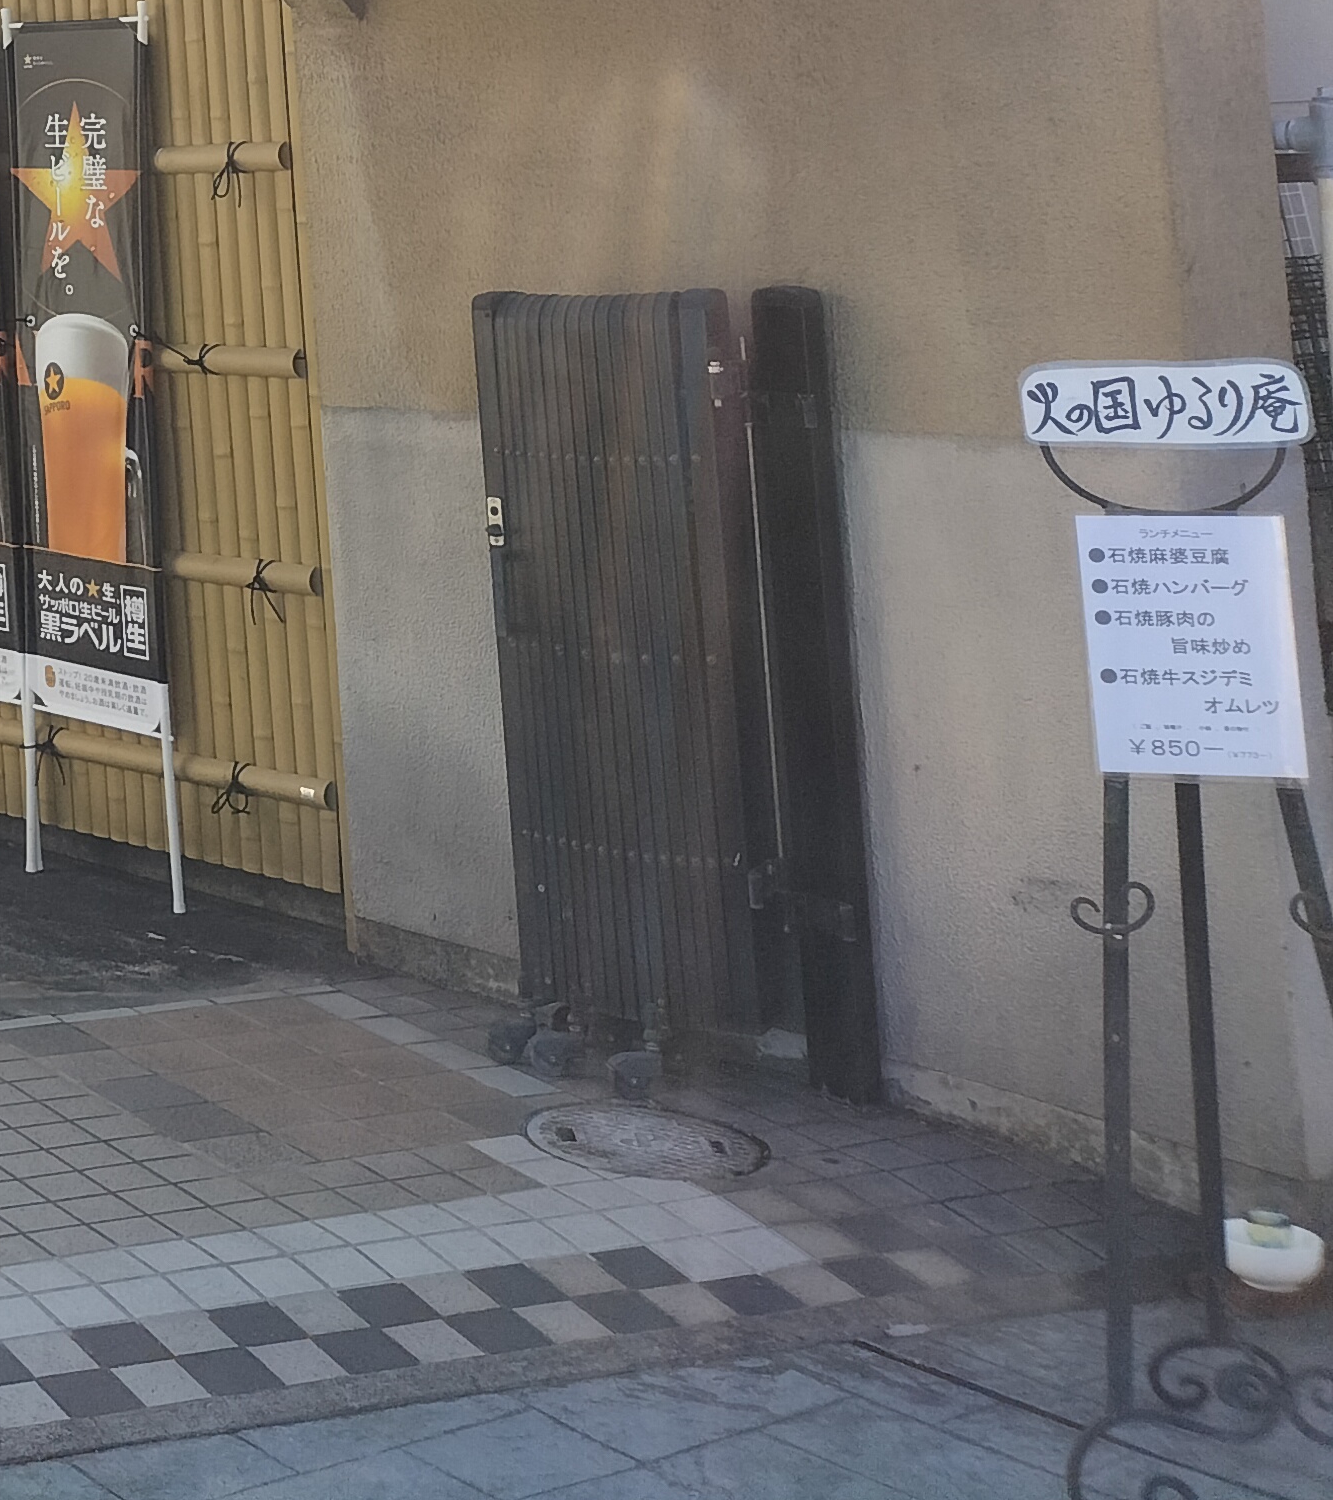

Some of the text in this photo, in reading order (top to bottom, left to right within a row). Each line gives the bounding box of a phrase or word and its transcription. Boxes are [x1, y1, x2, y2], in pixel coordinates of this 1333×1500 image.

[80, 113, 108, 228] 完璧な
[44, 113, 74, 295] 生ビールを。
[1026, 373, 1303, 440] 火の国ゆるり庵
[1138, 528, 1213, 539] ランチメニュー
[1108, 547, 1230, 566] 石焼麻婆豆腐
[37, 570, 84, 596] 大人の
[1111, 577, 1249, 597] 石焼ハンバーグ
[39, 593, 120, 624] サッポロ生ビール
[1114, 609, 1215, 627] 石焼豚肉の
[40, 610, 121, 653] 黒ラベル
[125, 595, 146, 650] 樽生
[1120, 667, 1253, 687] 石焼牛スジデミ
[1204, 696, 1279, 715] オムレツ
